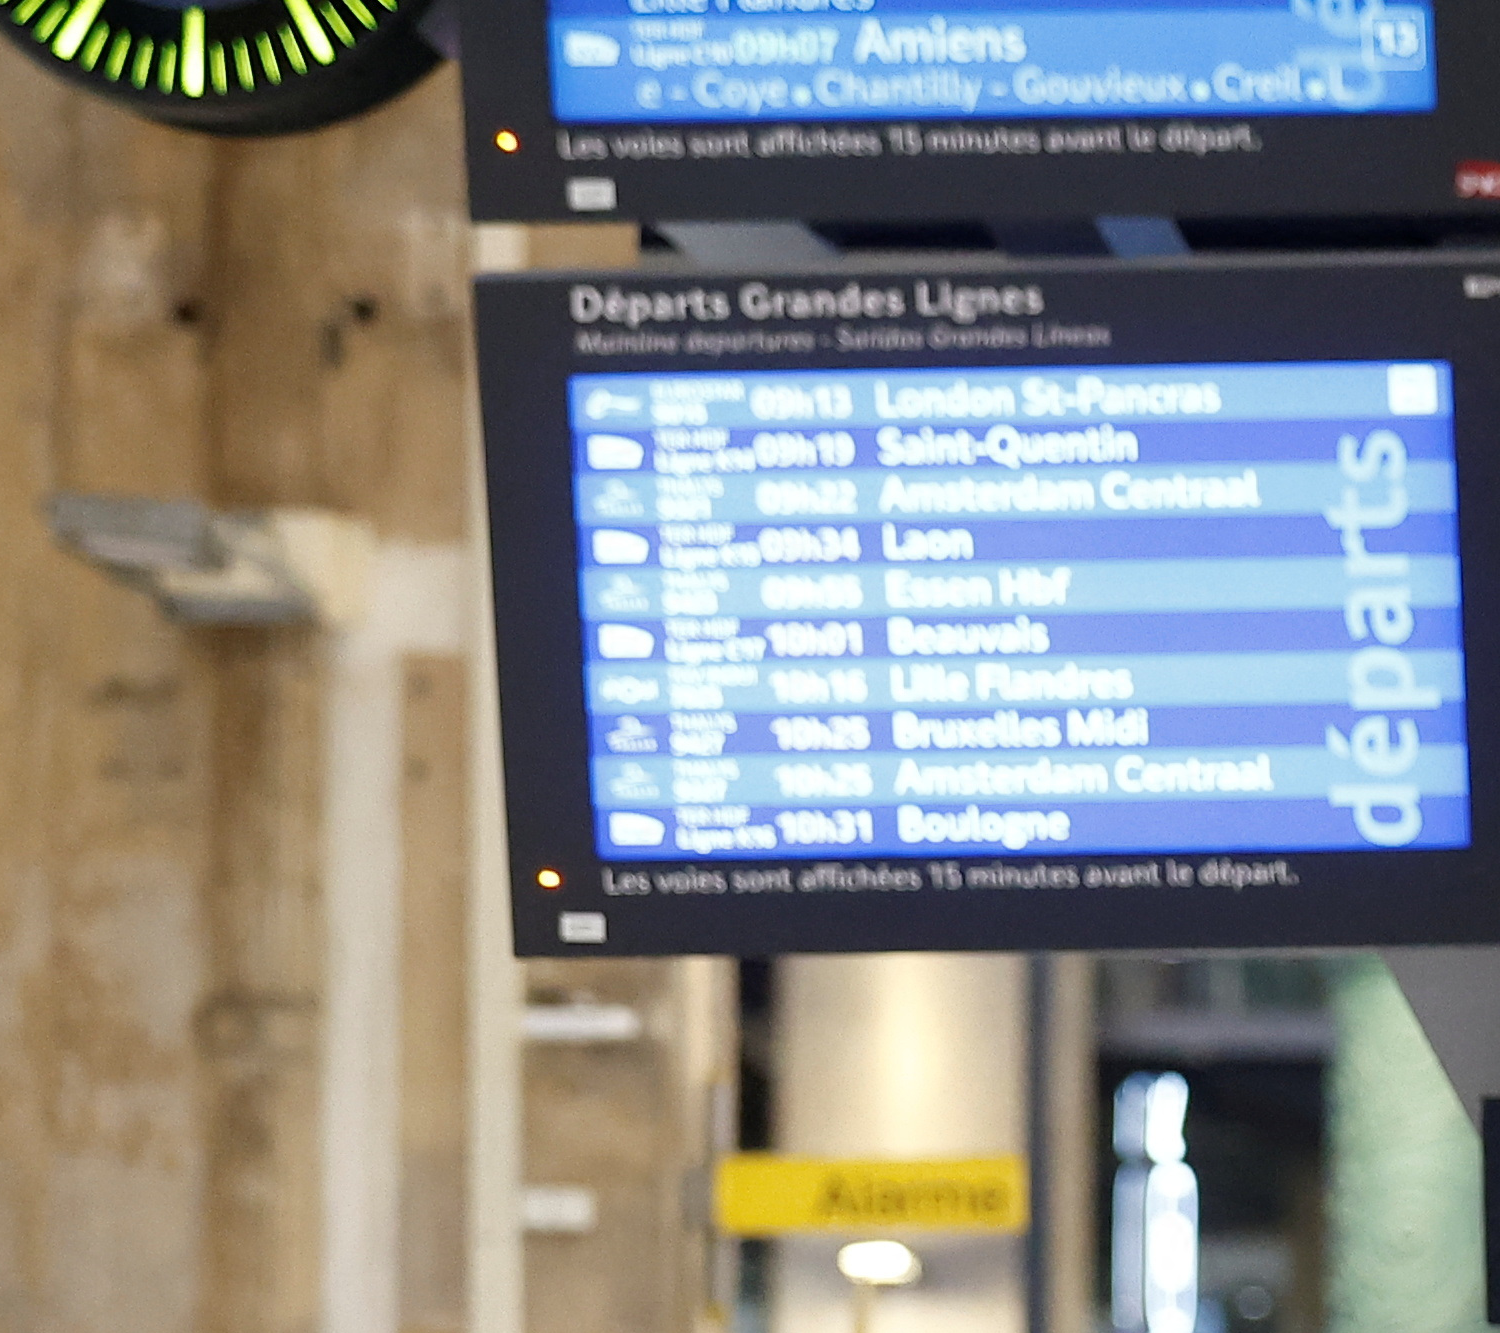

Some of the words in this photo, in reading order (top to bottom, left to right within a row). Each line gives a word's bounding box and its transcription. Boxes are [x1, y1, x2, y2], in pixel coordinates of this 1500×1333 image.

[732, 28, 840, 65] 09h07
[855, 16, 1027, 64] Amiens
[1377, 23, 1419, 57] 13
[692, 70, 788, 115] Coye
[814, 67, 983, 113] Chantilly
[1013, 65, 1187, 103] Gouvieux
[1213, 62, 1300, 102] Creil
[557, 131, 609, 160] Les
[611, 131, 686, 158] voies
[687, 130, 751, 157] sont
[754, 127, 882, 157] affichées
[924, 125, 1042, 154] minutes
[1043, 125, 1123, 153] avant
[570, 284, 731, 327] Départs
[738, 281, 905, 321] Grandes
[913, 279, 1045, 324] Lignes
[750, 384, 853, 420] 09h13
[875, 378, 1015, 418] London
[1021, 375, 1222, 417] St-Pancras
[753, 431, 856, 467] 09h19
[876, 424, 1139, 469] Saint-Quentin
[879, 473, 1094, 513] Amsterdam
[1100, 469, 1261, 510] Centraal
[882, 521, 974, 562] Laon
[885, 570, 992, 609] Essen
[998, 566, 1071, 608] Hbf
[887, 614, 1051, 656] Beauvais
[1323, 430, 1443, 847] départs
[889, 662, 970, 702] Lille
[975, 661, 1134, 702] Flandres
[892, 709, 1061, 749] Bruxelles
[1067, 706, 1149, 747] Midi
[894, 756, 1107, 796] Amsterdam
[1114, 752, 1274, 794] Centraal
[898, 804, 1070, 850] Boulogne
[602, 866, 652, 896] Les
[655, 866, 728, 894] voies
[731, 864, 794, 893] sont
[799, 861, 922, 893] affichées
[929, 862, 963, 890] 15
[966, 860, 1081, 889] minutes
[1082, 859, 1162, 888] avant
[1165, 858, 1194, 886] le
[1199, 857, 1300, 889] départ.
[816, 1174, 1008, 1221] Alarme
